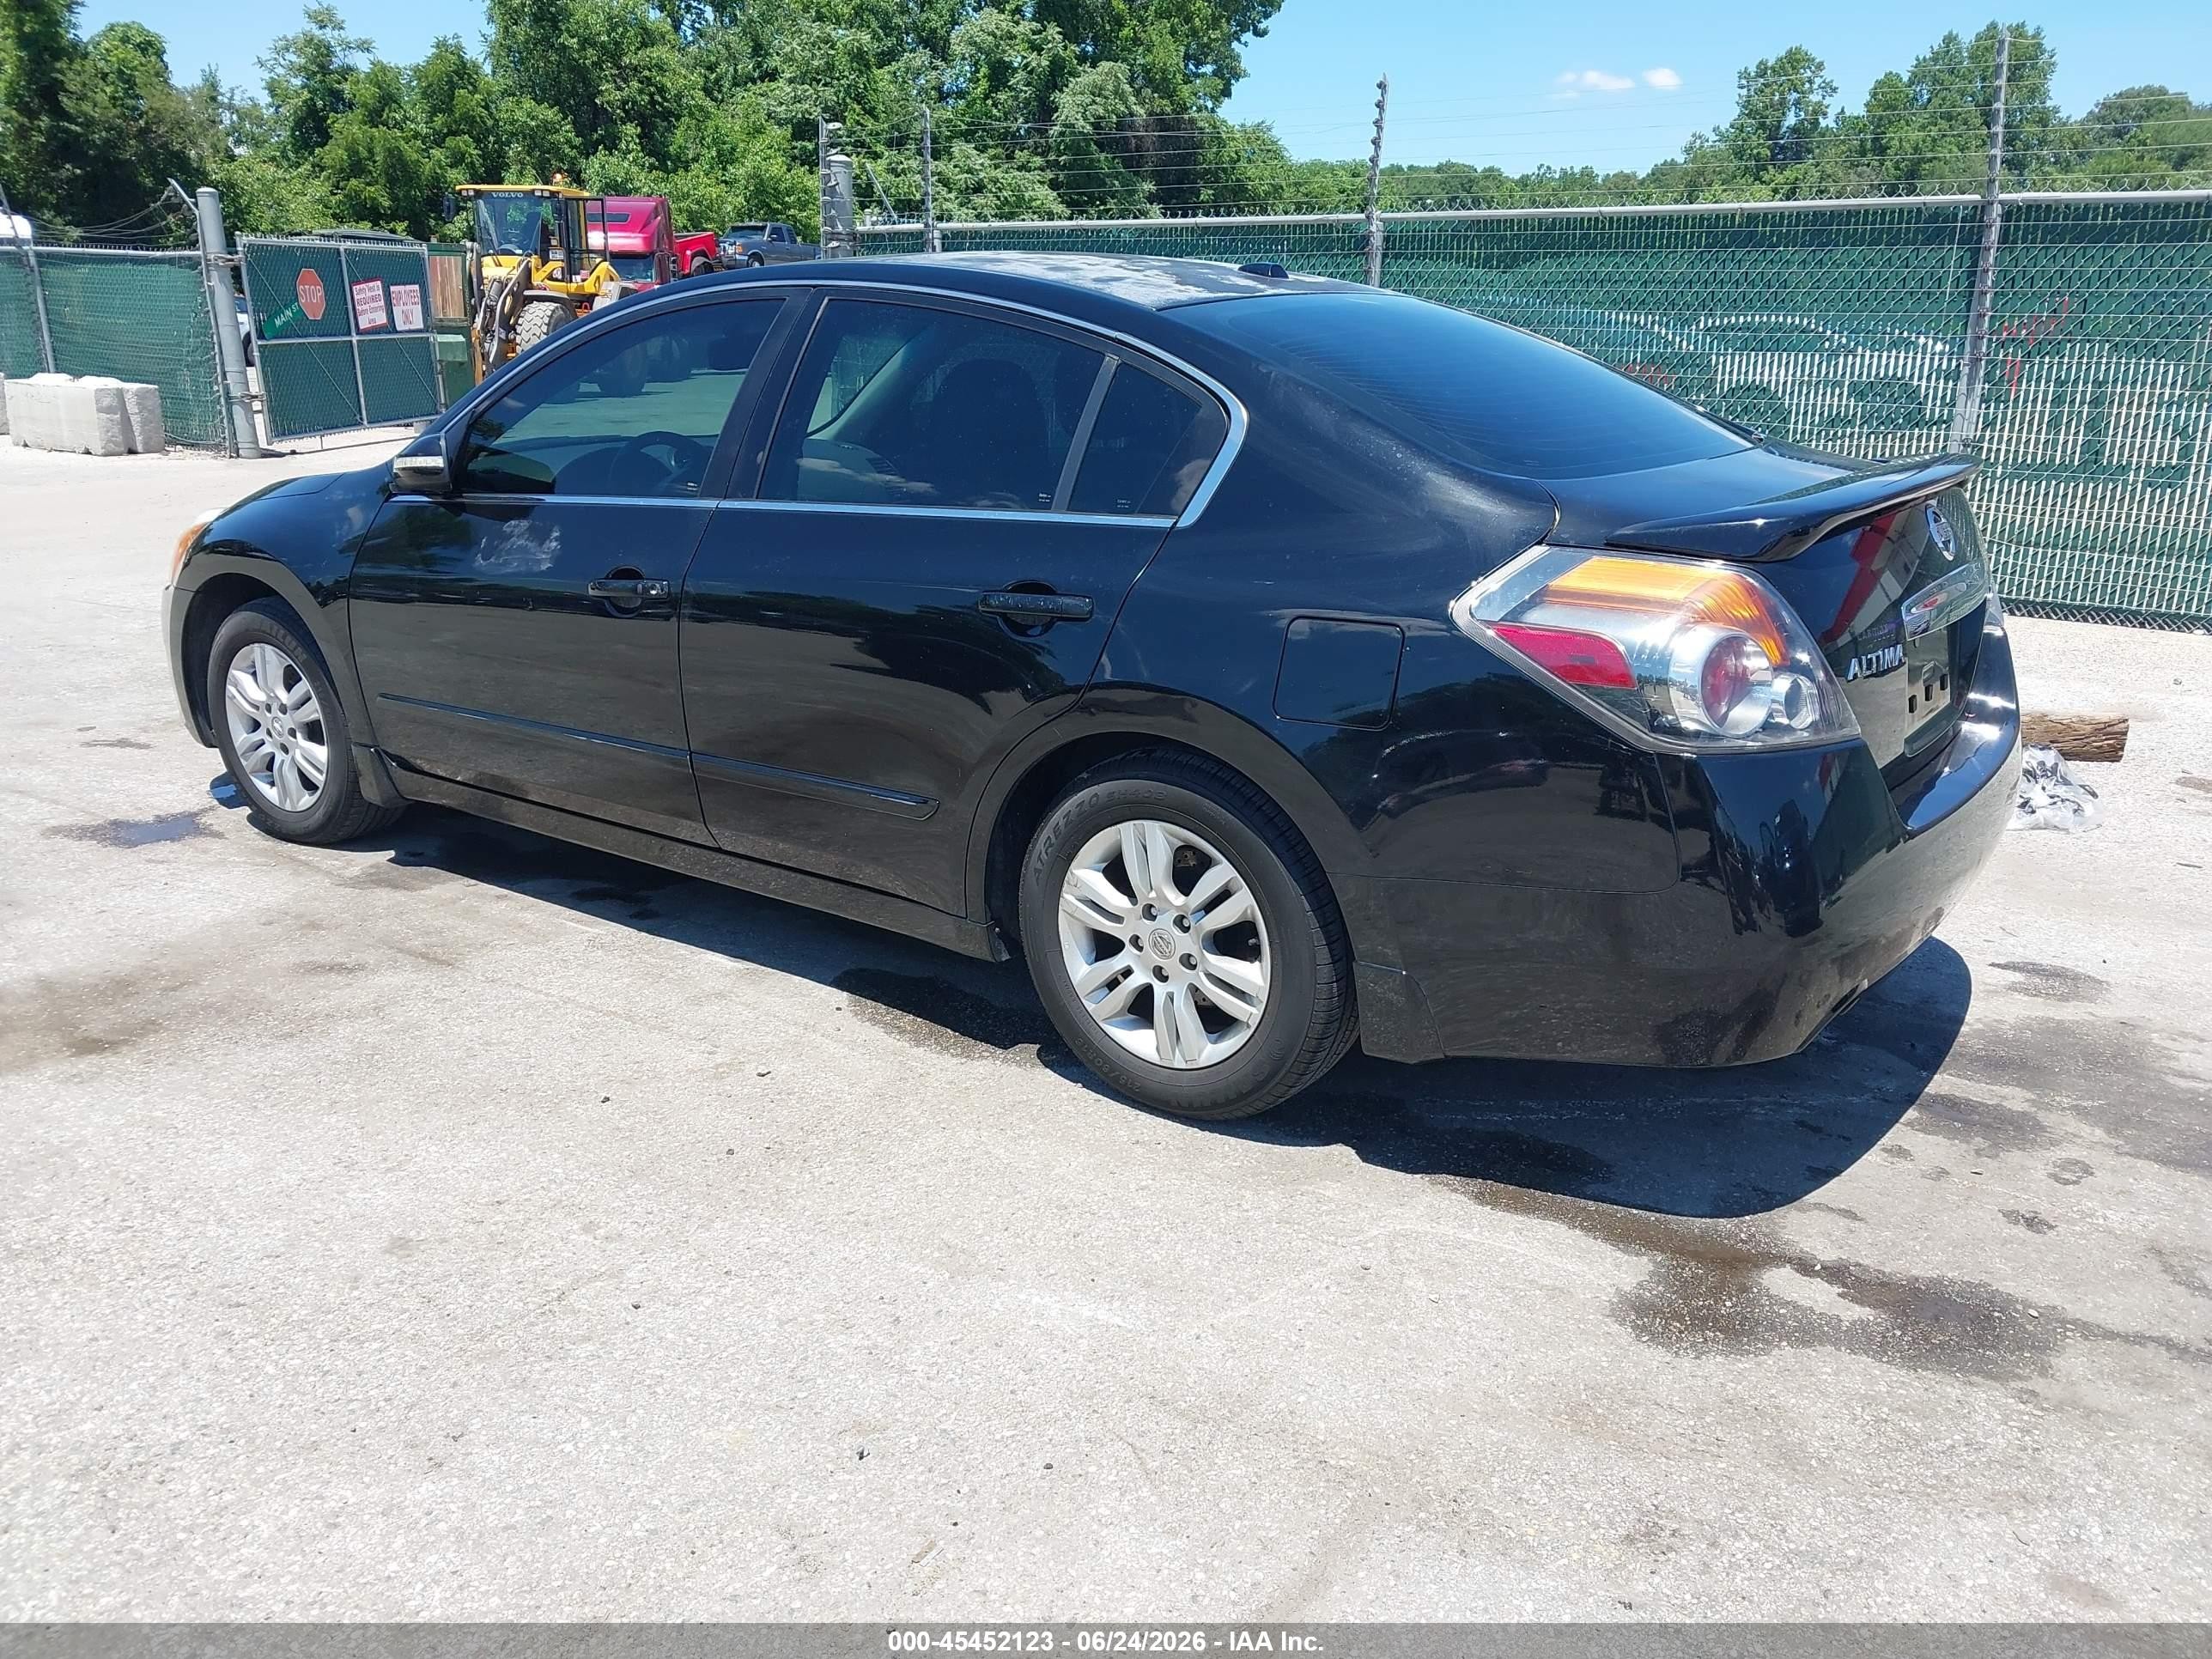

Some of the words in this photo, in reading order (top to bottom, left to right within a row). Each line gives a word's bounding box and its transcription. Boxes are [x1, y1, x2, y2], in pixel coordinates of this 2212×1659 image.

[299, 284, 322, 303] STOP
[356, 294, 382, 307] REQUIRED
[392, 289, 420, 307] EMPLOYEES
[274, 308, 293, 329] MAIN
[292, 301, 300, 313] ST
[401, 309, 414, 325] ONLY
[1847, 643, 1905, 681] ALTIMA
[1033, 792, 1101, 887] ATREZZO
